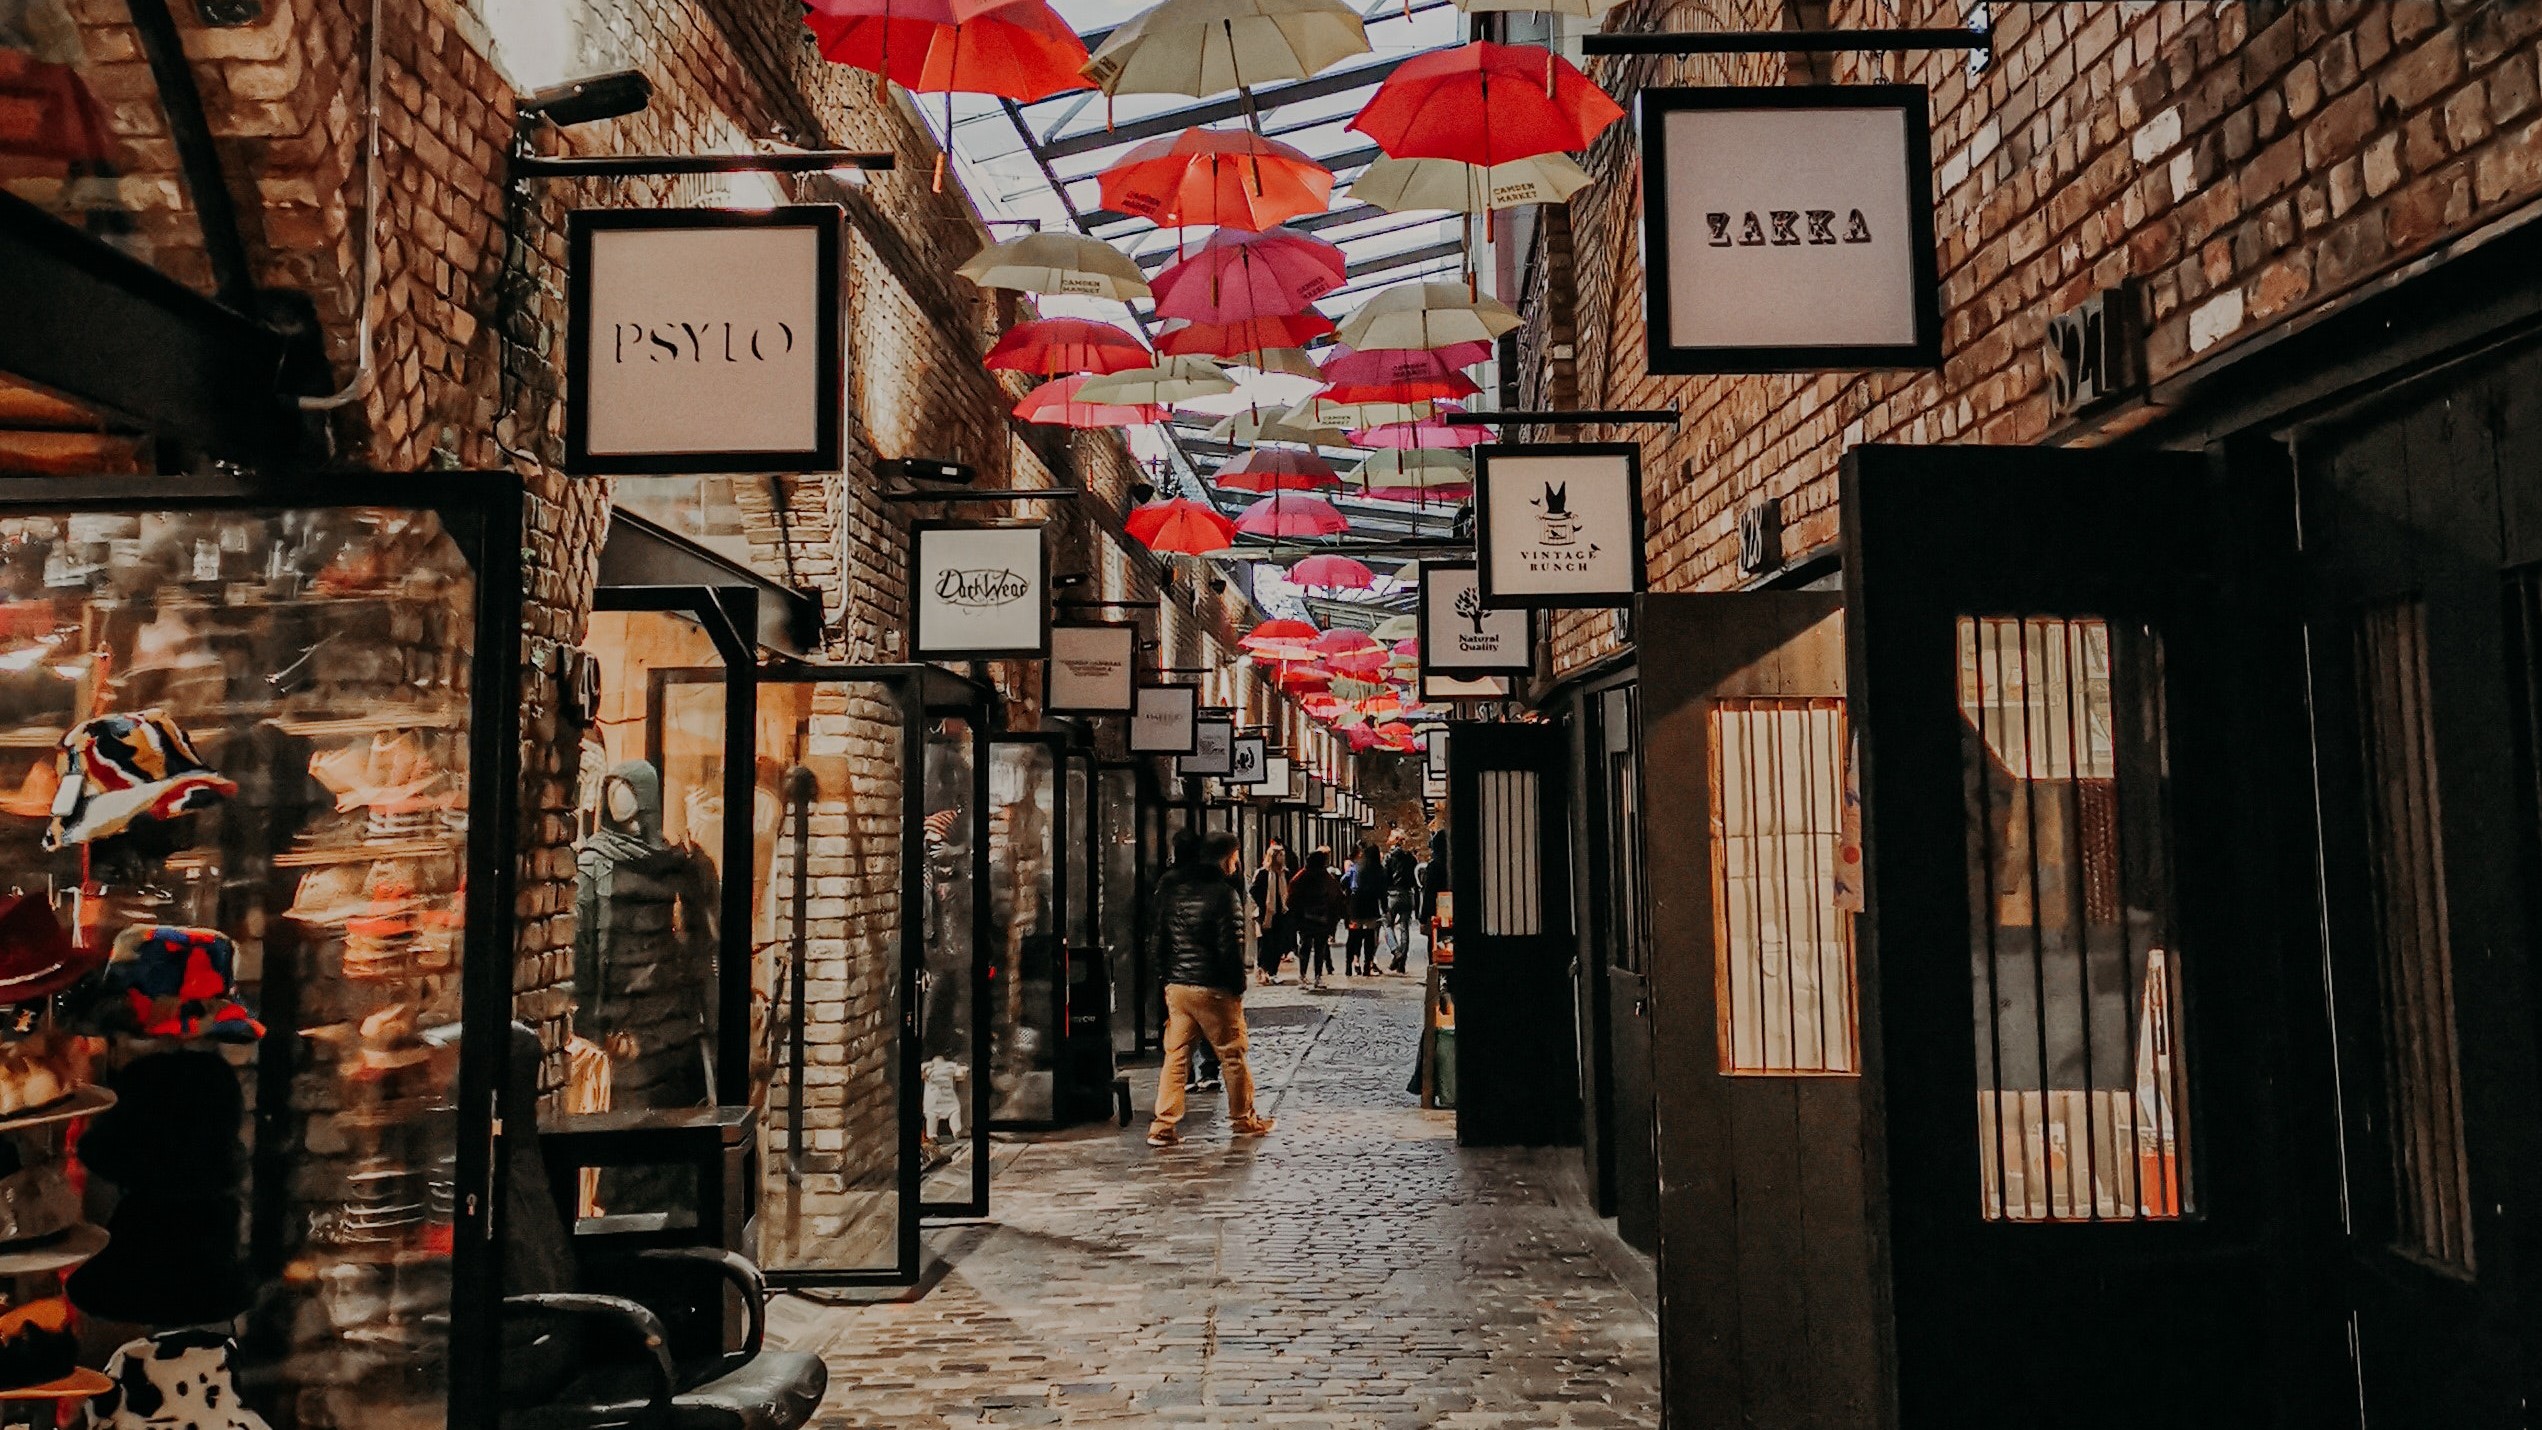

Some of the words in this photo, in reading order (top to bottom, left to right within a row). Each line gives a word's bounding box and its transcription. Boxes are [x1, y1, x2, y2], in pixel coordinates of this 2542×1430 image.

[1493, 183, 1535, 195] CAMDEN
[1497, 191, 1537, 203] MARKET
[1705, 207, 1872, 248] ZAKKA
[615, 322, 793, 364] PSYLO
[1520, 551, 1598, 560] VINTAGE
[1459, 633, 1500, 643] Natural
[1459, 643, 1499, 652] Quality
